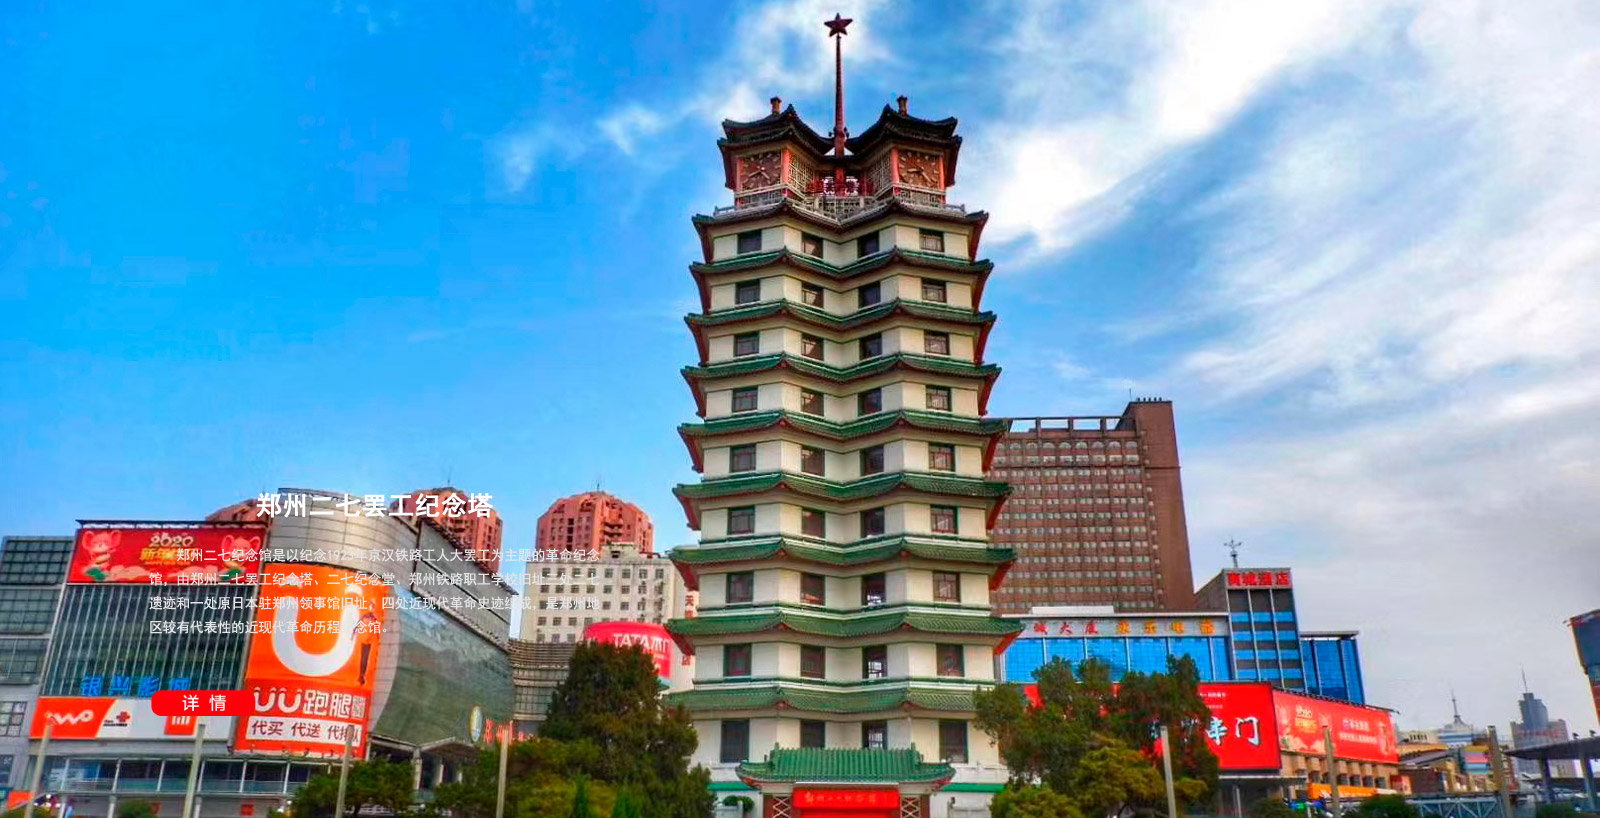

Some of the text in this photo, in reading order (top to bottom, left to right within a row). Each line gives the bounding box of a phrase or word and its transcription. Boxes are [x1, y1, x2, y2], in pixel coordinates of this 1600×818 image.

[149, 533, 194, 547] 2020
[252, 720, 283, 737] 代买
[291, 722, 321, 738] 代送
